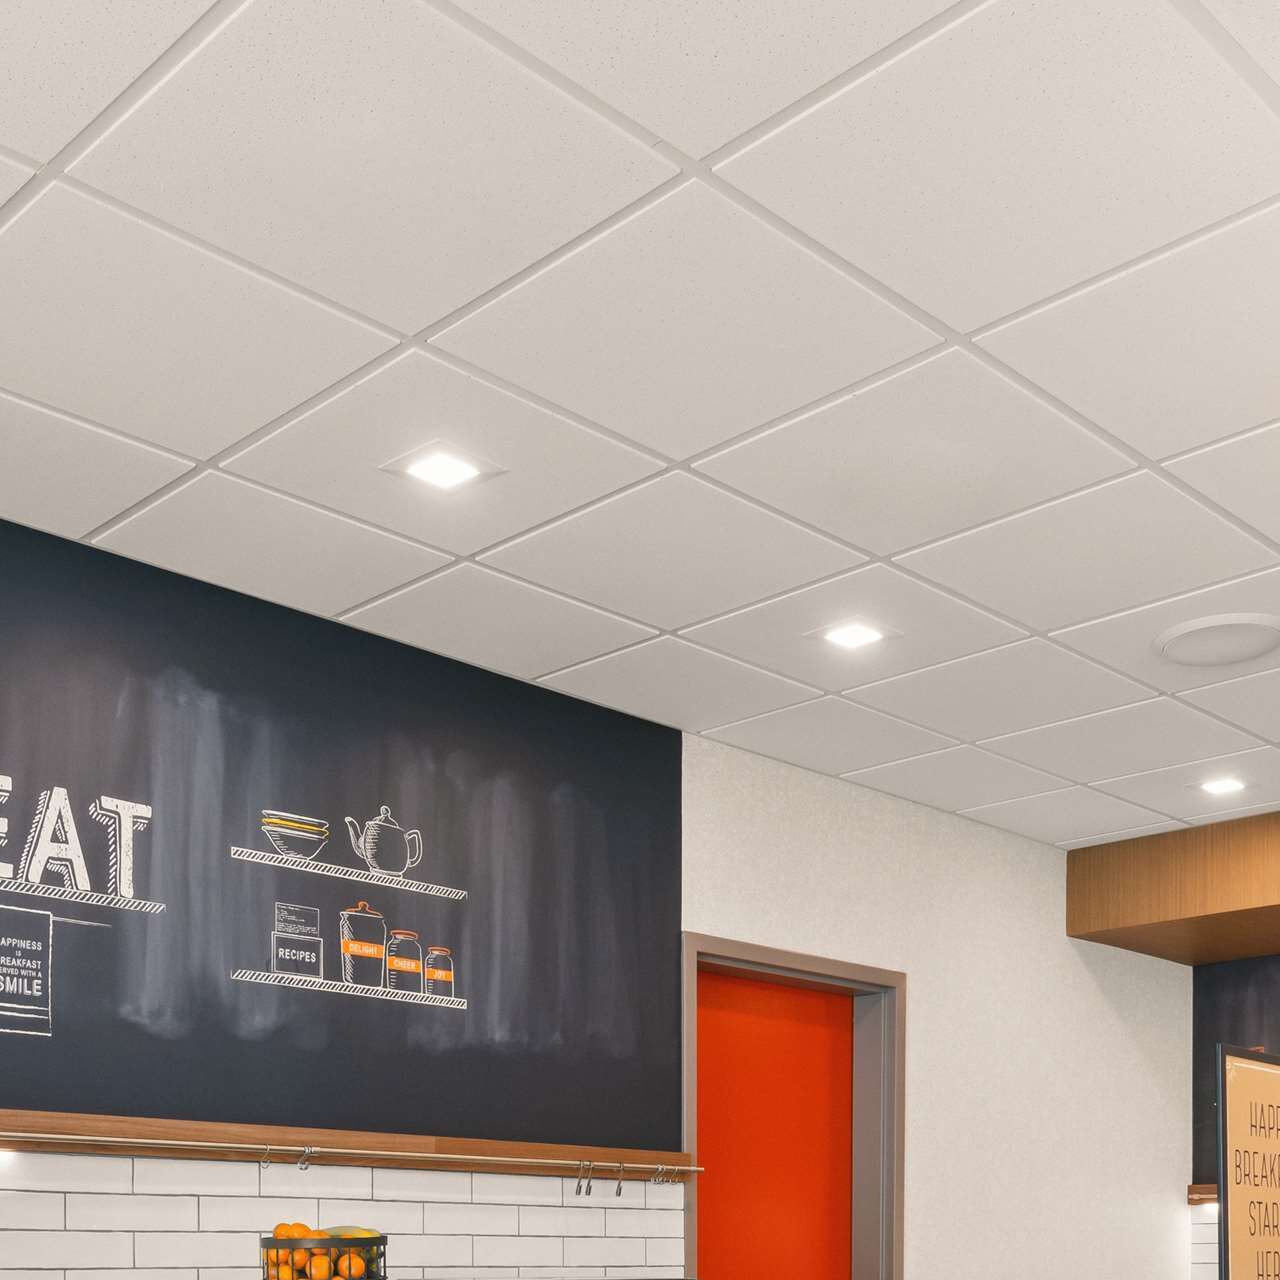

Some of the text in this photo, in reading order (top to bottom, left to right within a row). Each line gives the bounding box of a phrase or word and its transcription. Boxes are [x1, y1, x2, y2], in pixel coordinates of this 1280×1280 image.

[348, 943, 378, 955] DELIGHT
[278, 947, 317, 963] RECIPES
[393, 959, 416, 970] CHEER
[20, 969, 36, 977] WITH
[433, 970, 446, 980] JOY
